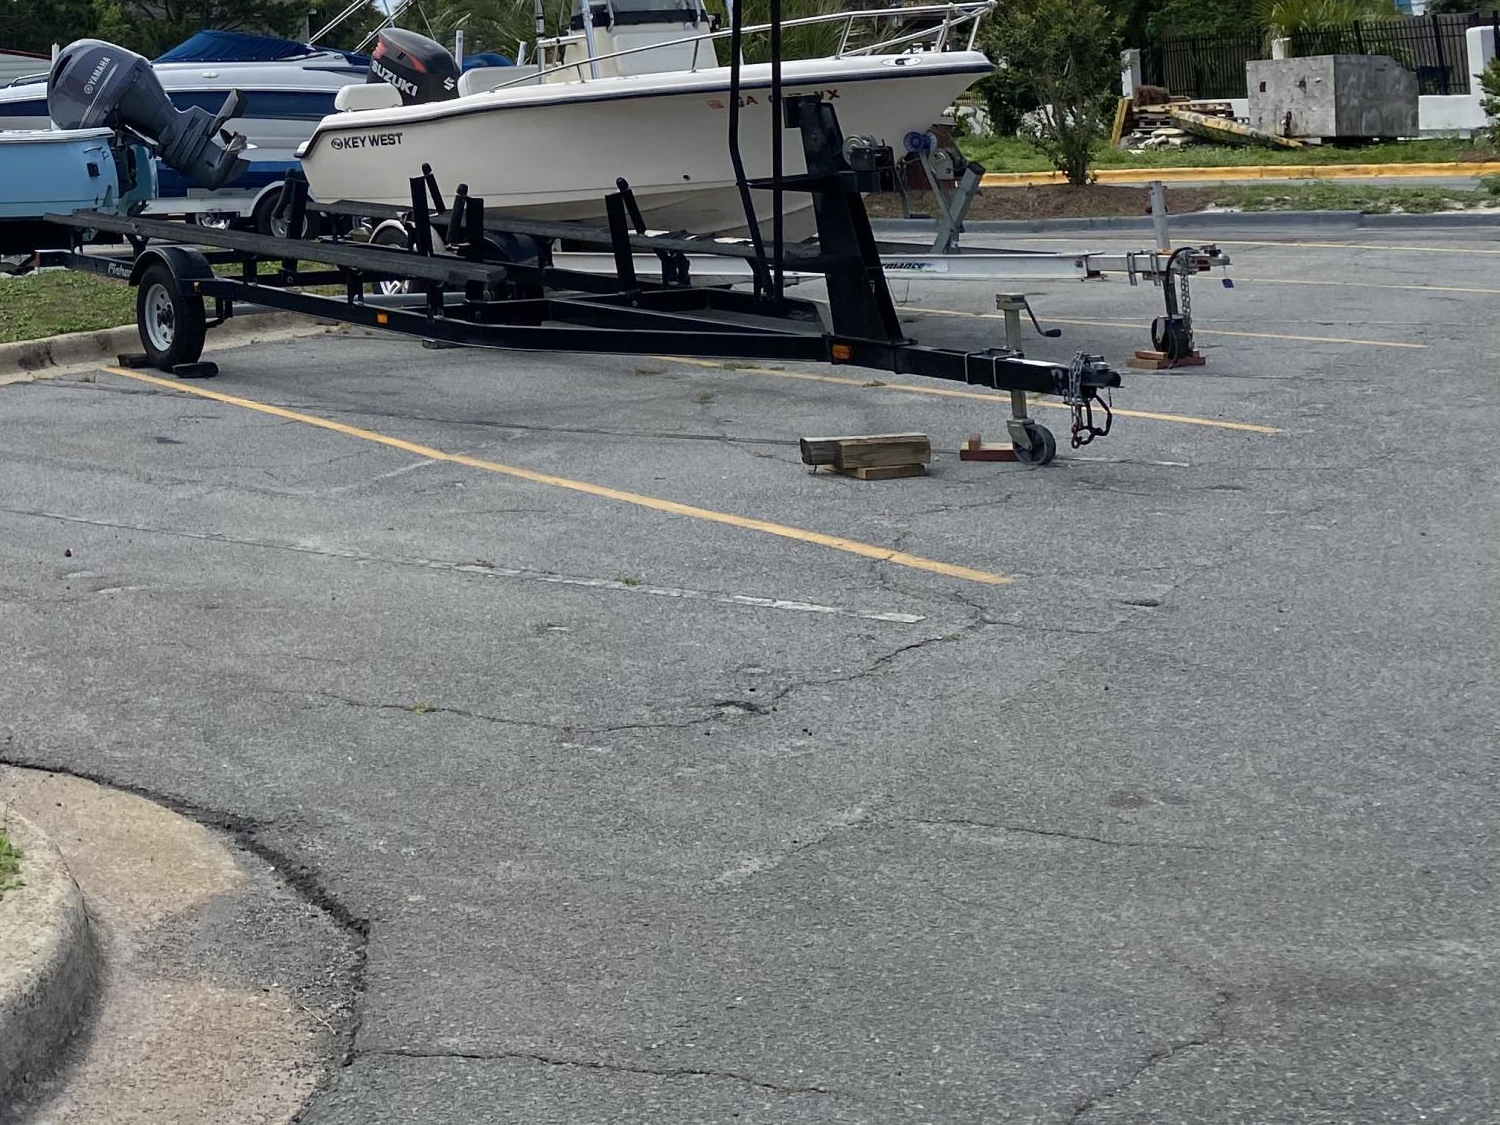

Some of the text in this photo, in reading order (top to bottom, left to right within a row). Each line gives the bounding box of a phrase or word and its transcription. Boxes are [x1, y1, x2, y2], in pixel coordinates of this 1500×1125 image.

[87, 56, 111, 86] YAMAHA
[371, 60, 418, 97] SUZUKI
[343, 136, 367, 149] KEY
[368, 132, 403, 147] WEST
